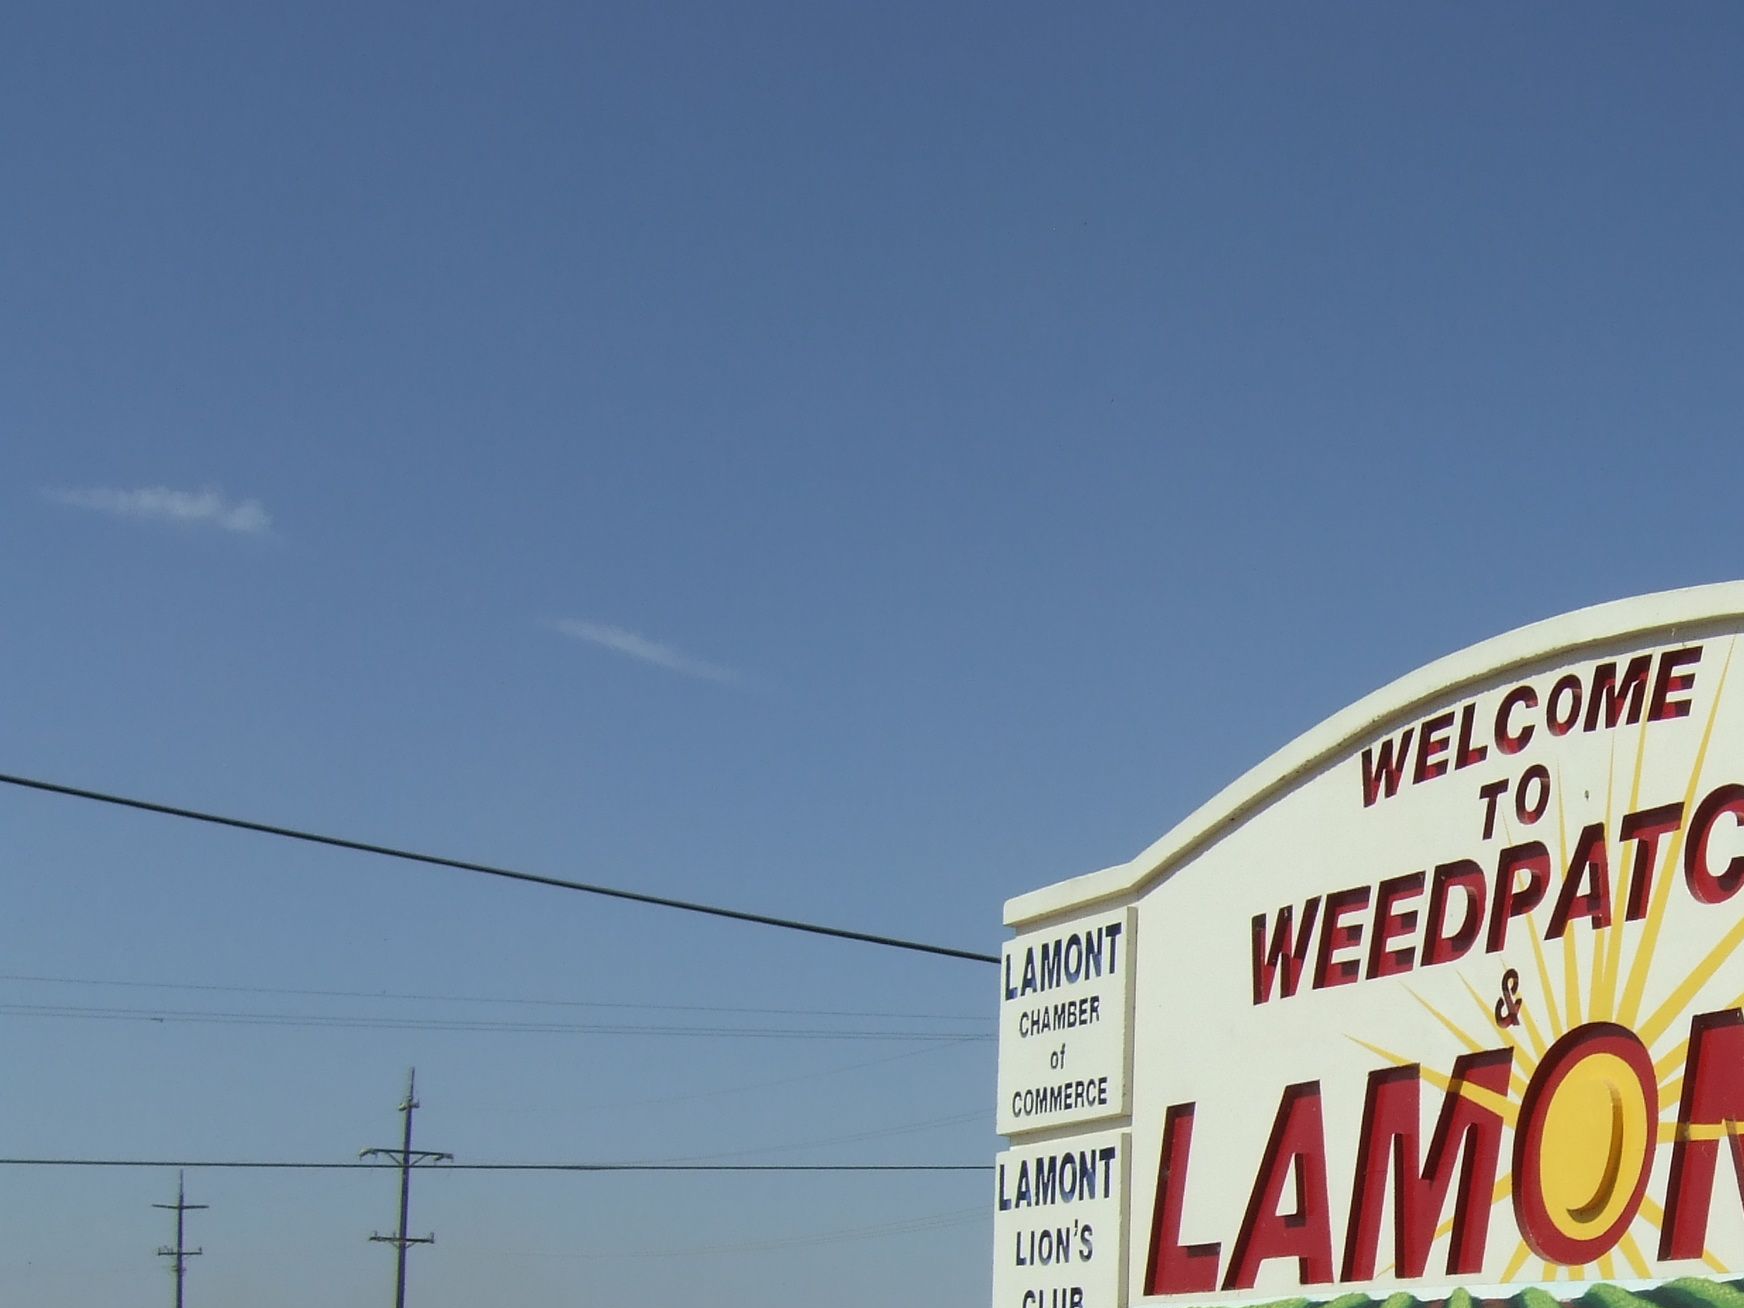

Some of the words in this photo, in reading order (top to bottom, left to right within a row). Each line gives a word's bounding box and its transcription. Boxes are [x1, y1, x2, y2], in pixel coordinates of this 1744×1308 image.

[1360, 646, 1703, 807] WELCOME
[1479, 765, 1551, 840] TO
[1004, 922, 1122, 1001] LAMONT
[1019, 996, 1100, 1039] CHAMBER
[1494, 970, 1522, 1027] &
[1050, 1043, 1066, 1070] of
[1012, 1077, 1108, 1118] COMMERCE
[999, 1146, 1116, 1212] LAMONT
[1016, 1219, 1093, 1266] LION'S
